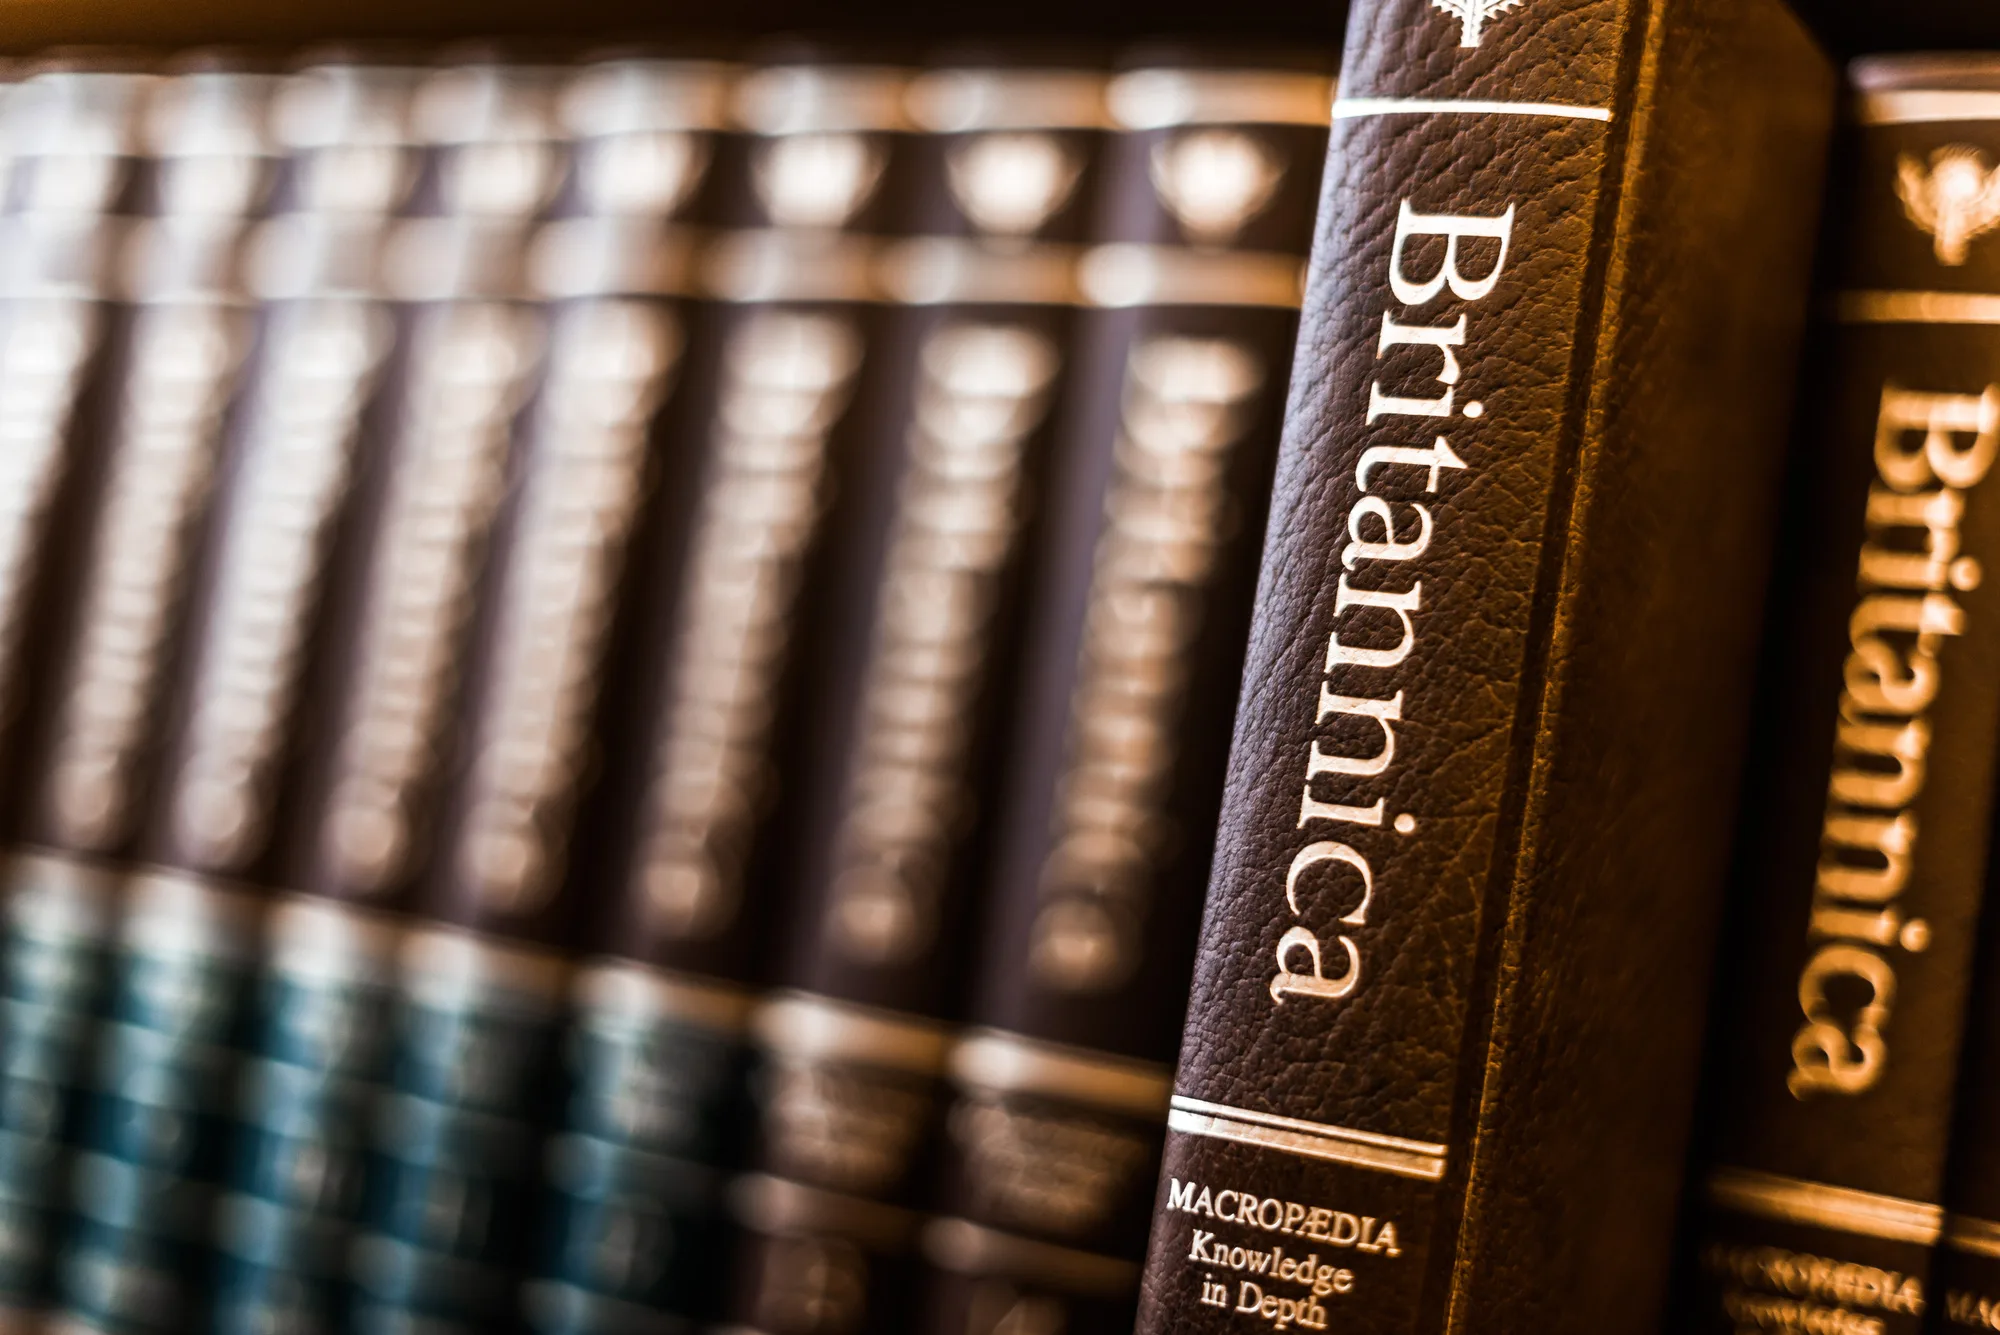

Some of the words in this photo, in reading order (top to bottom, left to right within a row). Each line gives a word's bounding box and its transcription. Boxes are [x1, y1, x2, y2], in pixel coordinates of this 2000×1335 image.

[1270, 198, 1515, 1006] Britannica
[1787, 382, 2000, 1100] Britannica
[1166, 1178, 1401, 1257] MACROPÆDIA
[1188, 1229, 1355, 1296] Knowledge
[1201, 1273, 1228, 1308] in
[1235, 1281, 1328, 1330] Depth
